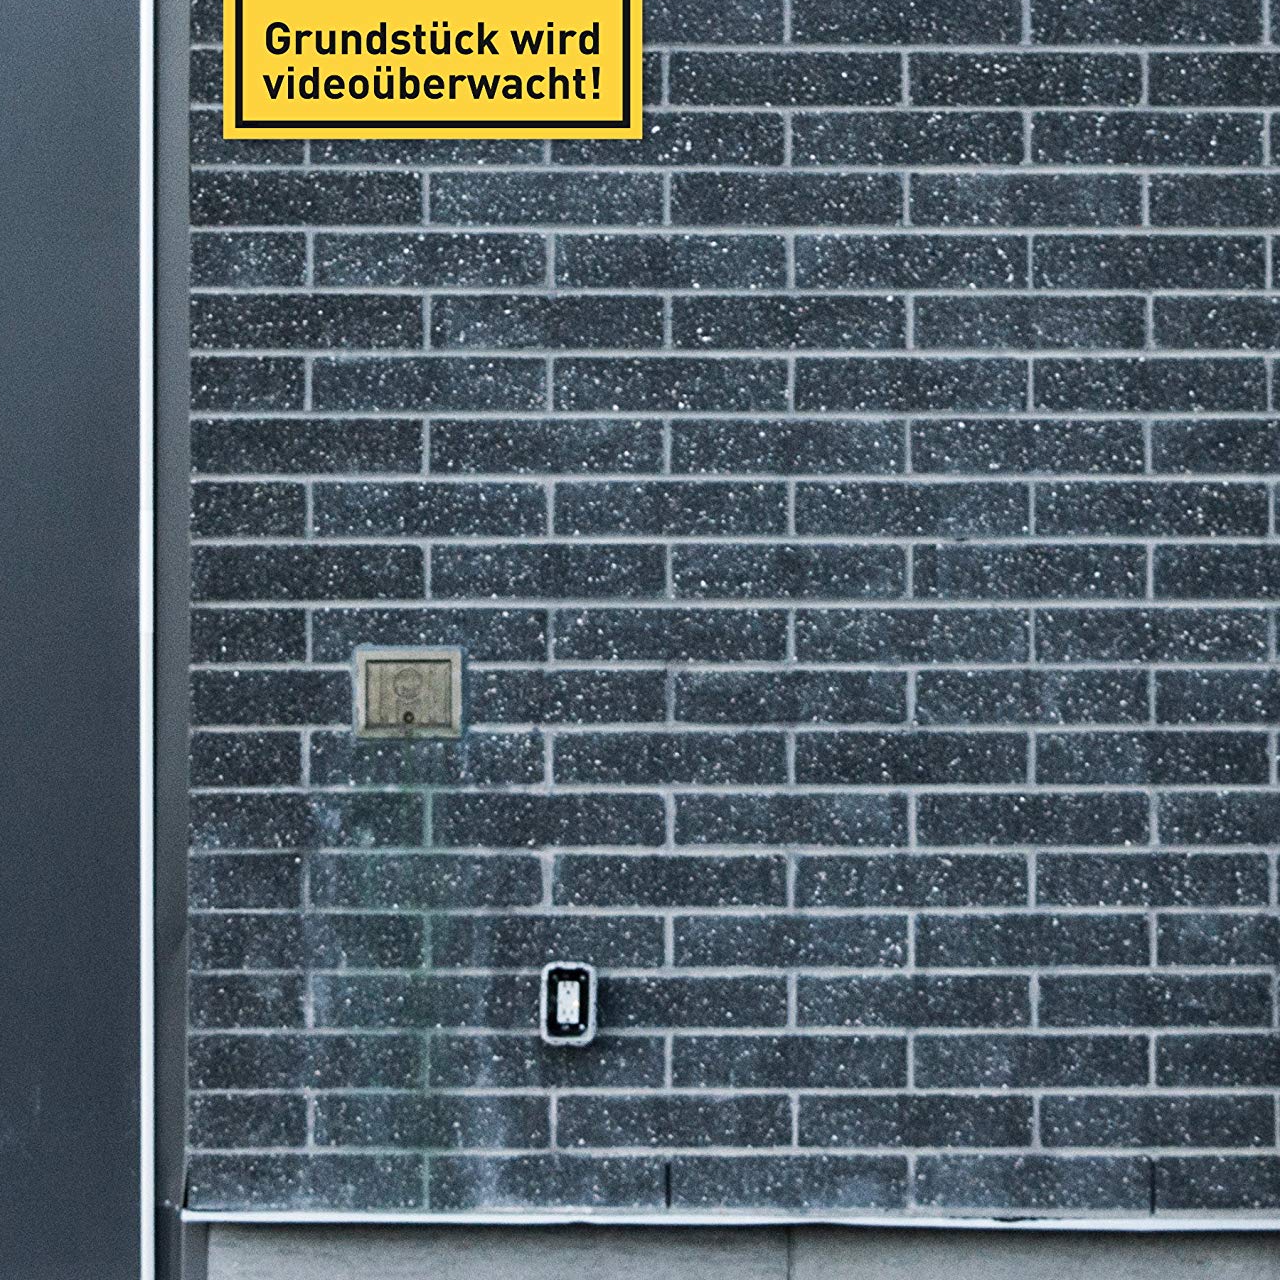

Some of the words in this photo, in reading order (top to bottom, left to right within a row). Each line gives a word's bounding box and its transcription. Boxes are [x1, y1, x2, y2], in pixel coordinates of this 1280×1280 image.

[265, 21, 499, 55] Grundstück
[510, 21, 600, 55] wird
[262, 66, 600, 100] videoüberwacht!
